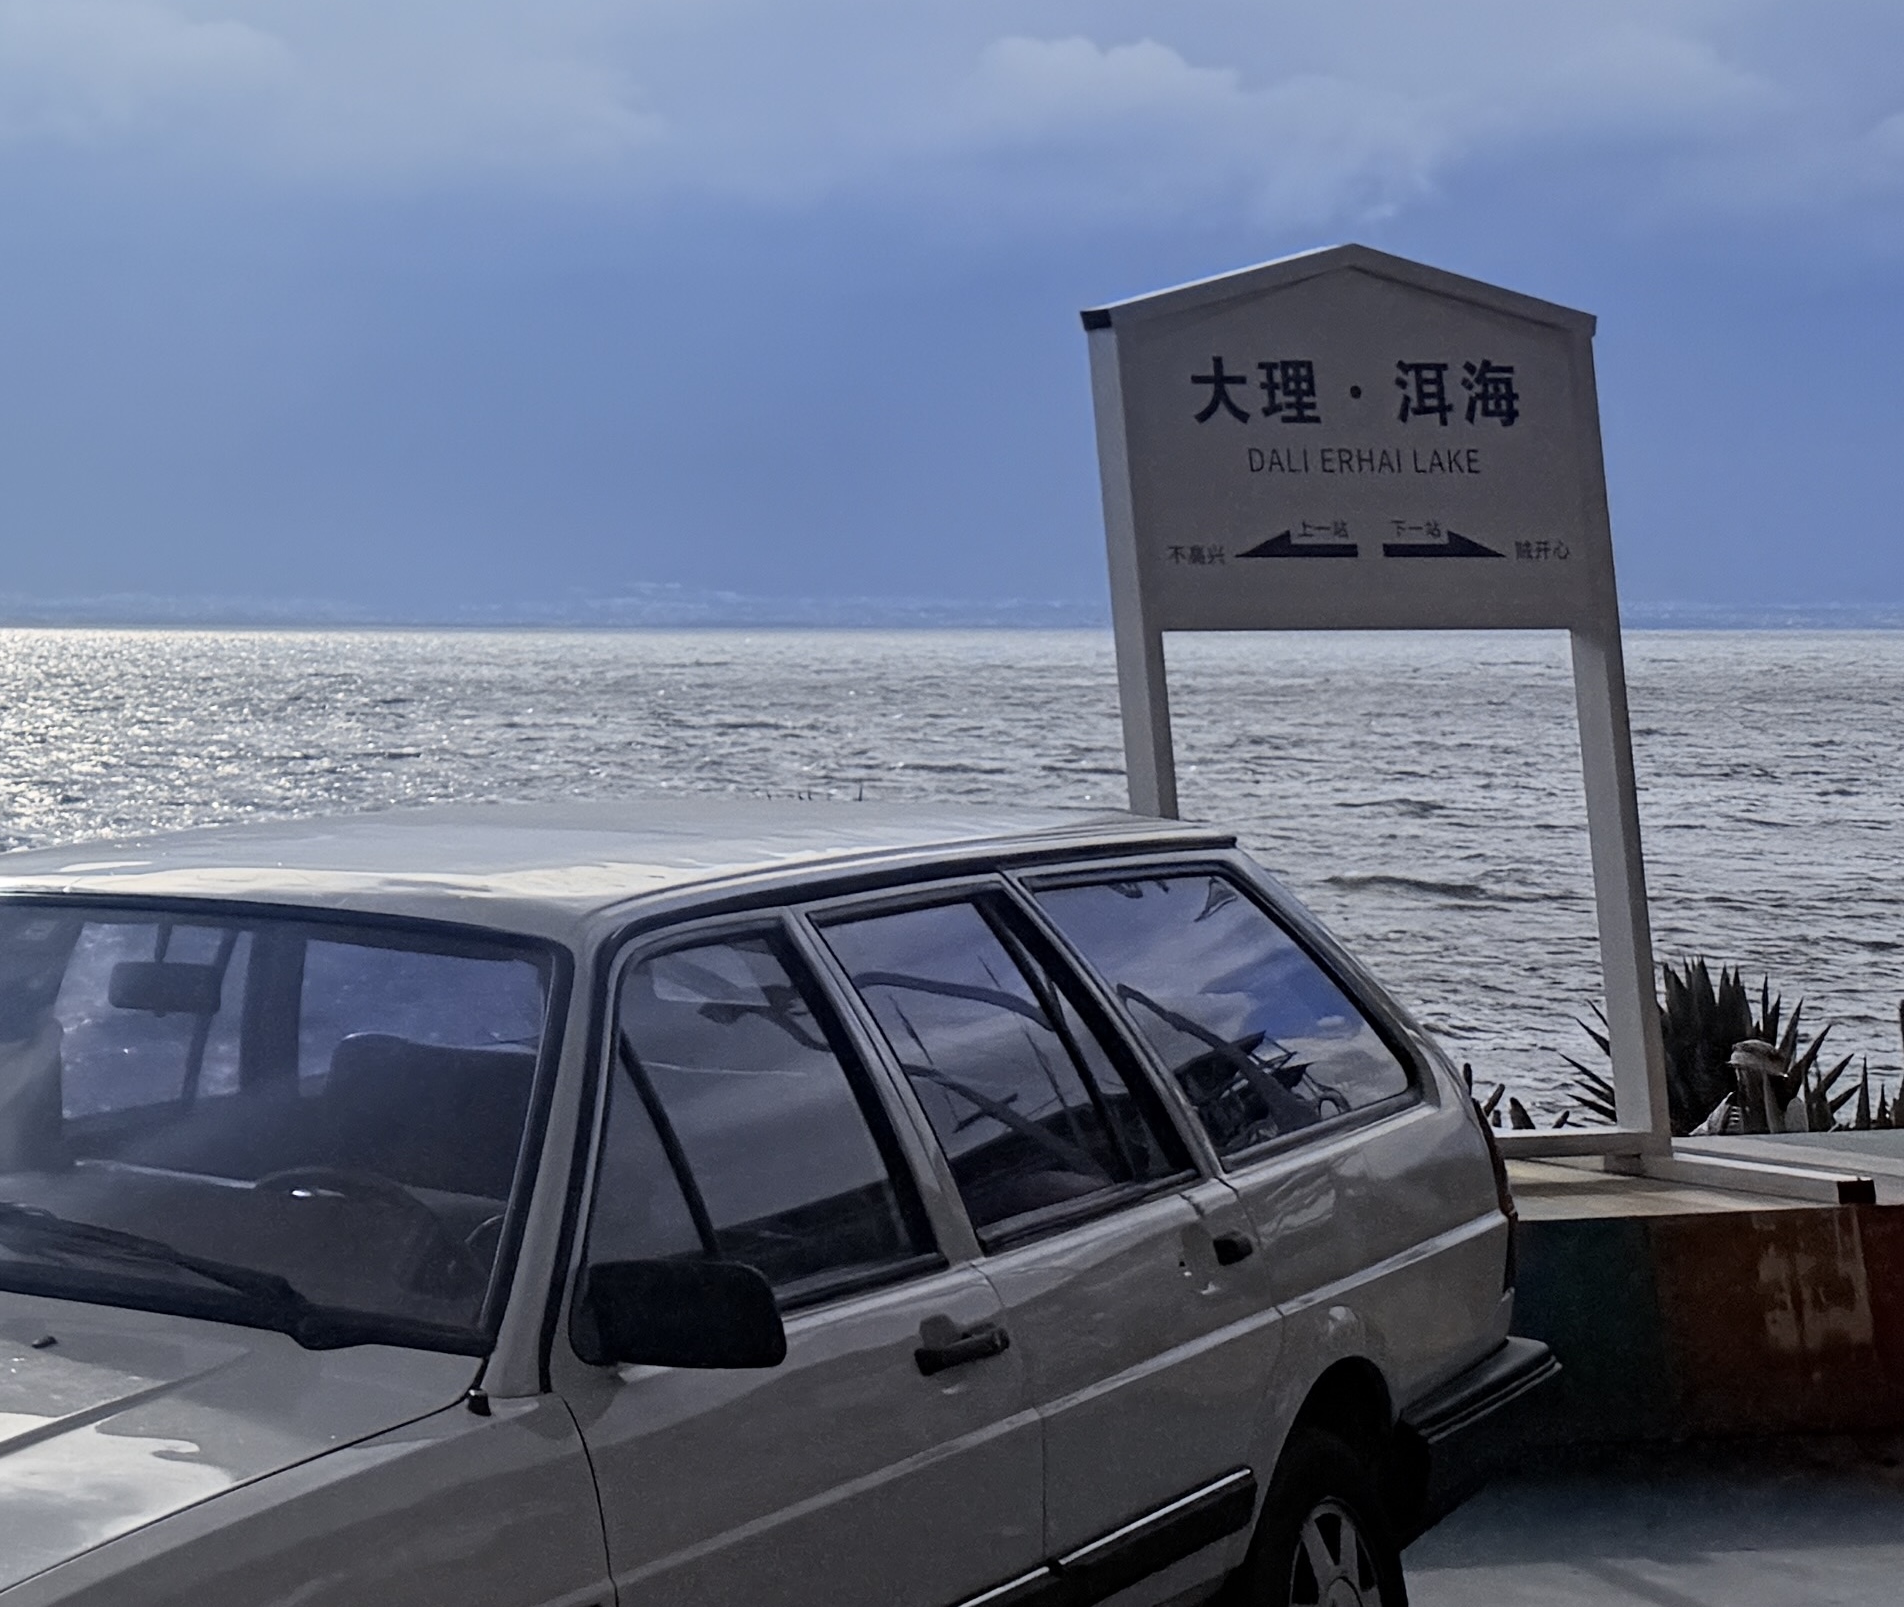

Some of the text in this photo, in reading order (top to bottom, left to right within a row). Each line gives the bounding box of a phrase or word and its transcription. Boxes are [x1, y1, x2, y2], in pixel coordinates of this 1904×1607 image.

[1248, 447, 1482, 474] DALI ERHAI LAKE
